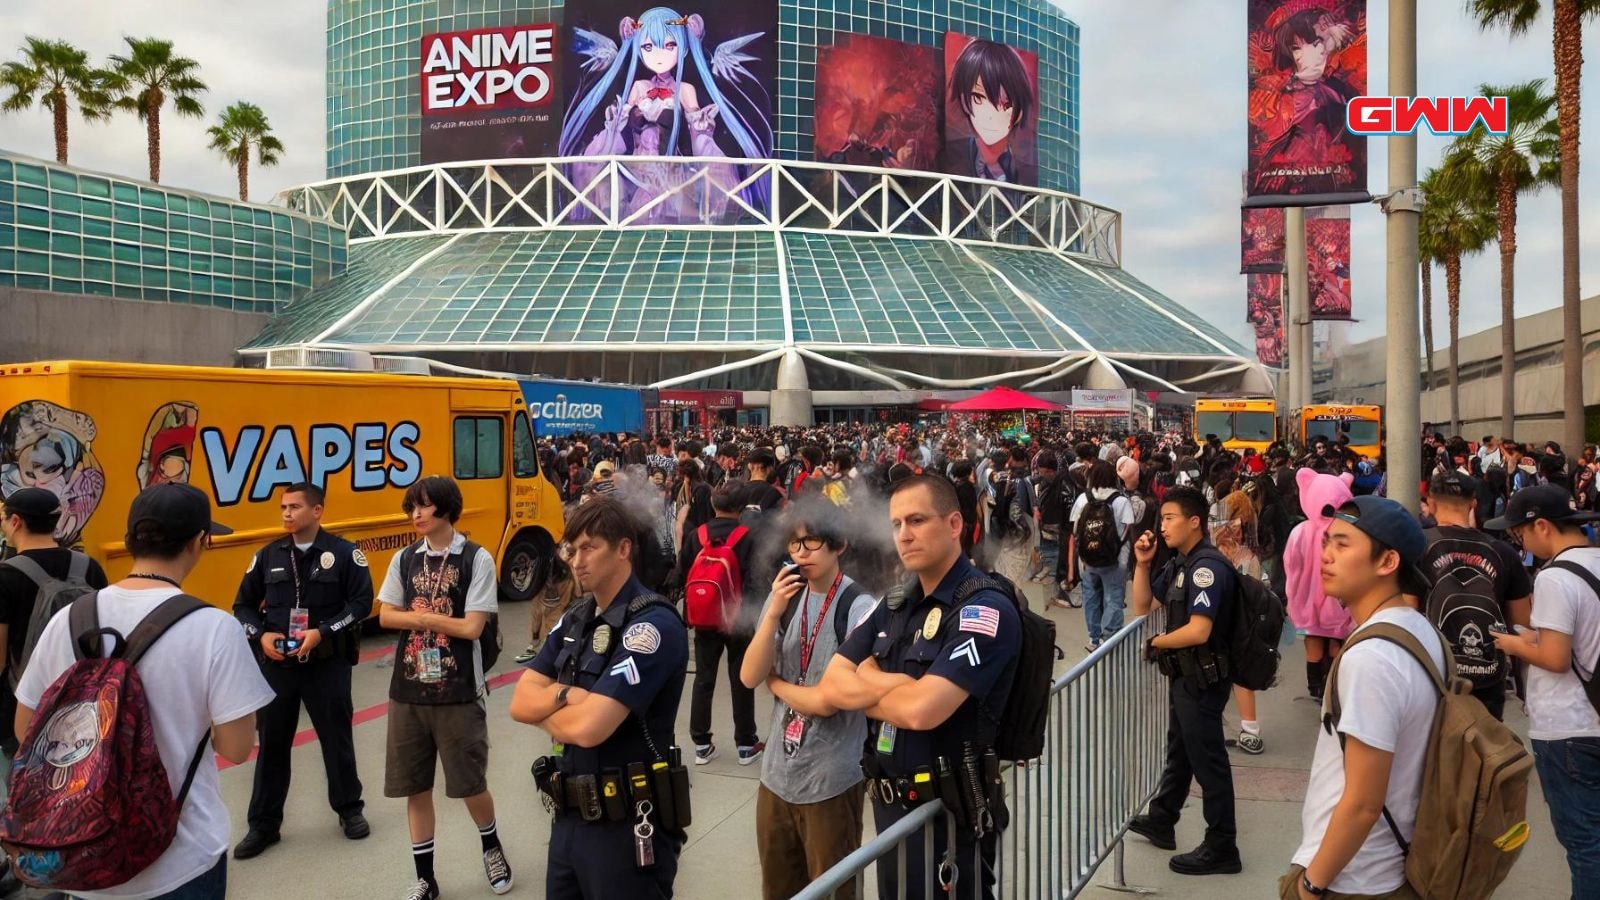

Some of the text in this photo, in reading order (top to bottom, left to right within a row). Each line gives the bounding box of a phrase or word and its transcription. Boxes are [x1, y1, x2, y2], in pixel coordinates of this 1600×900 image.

[423, 28, 553, 73] ANIME
[428, 66, 550, 109] EXPO
[200, 420, 422, 507] VAPES
